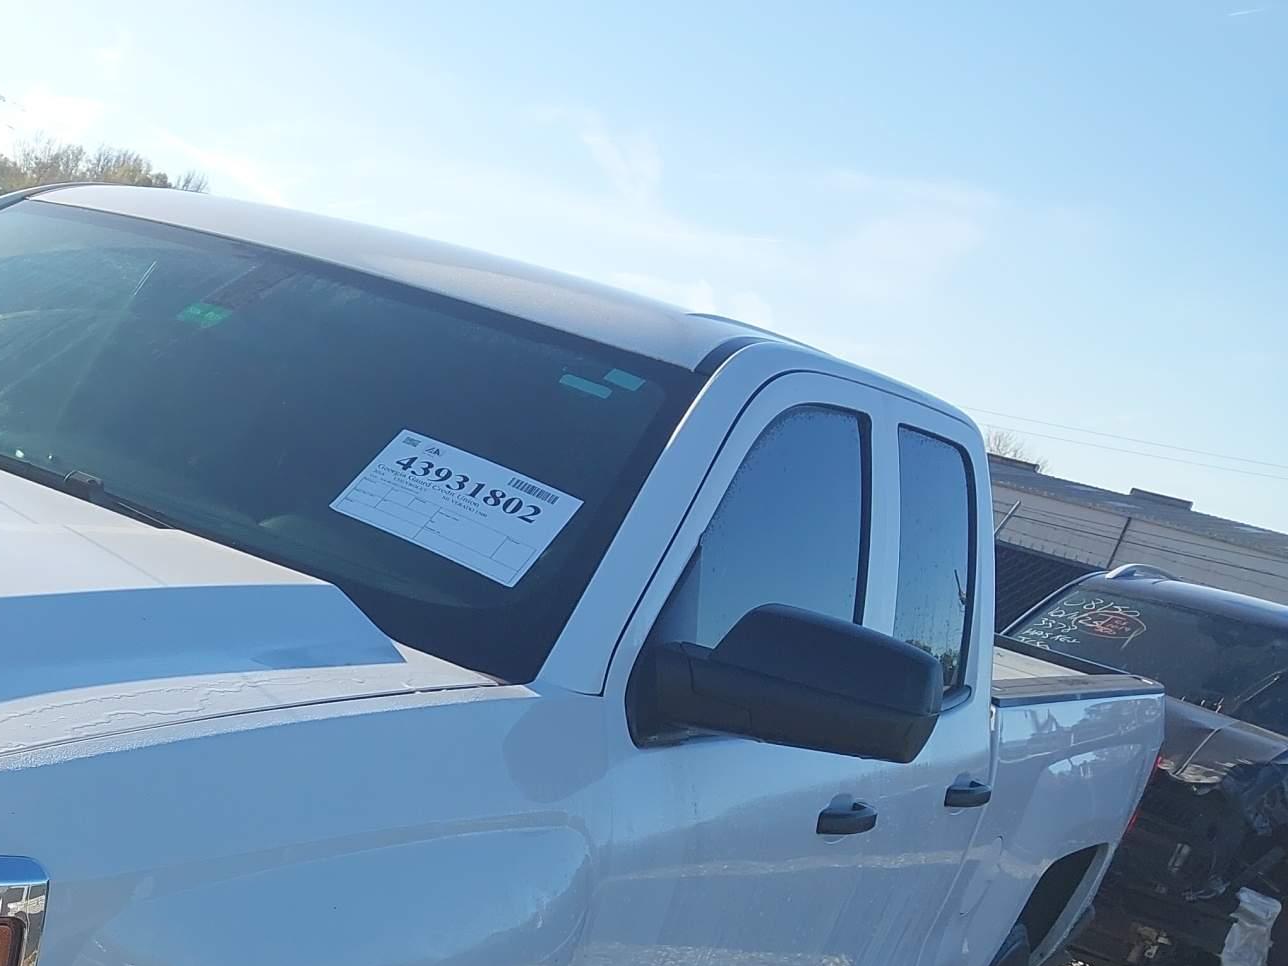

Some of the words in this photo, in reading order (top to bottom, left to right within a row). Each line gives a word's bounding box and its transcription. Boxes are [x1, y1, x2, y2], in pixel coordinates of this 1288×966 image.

[378, 463, 407, 478] Georgia
[408, 475, 432, 488] Guard
[432, 484, 456, 498] Credit
[457, 494, 480, 508] Union
[396, 456, 542, 524] 43931802
